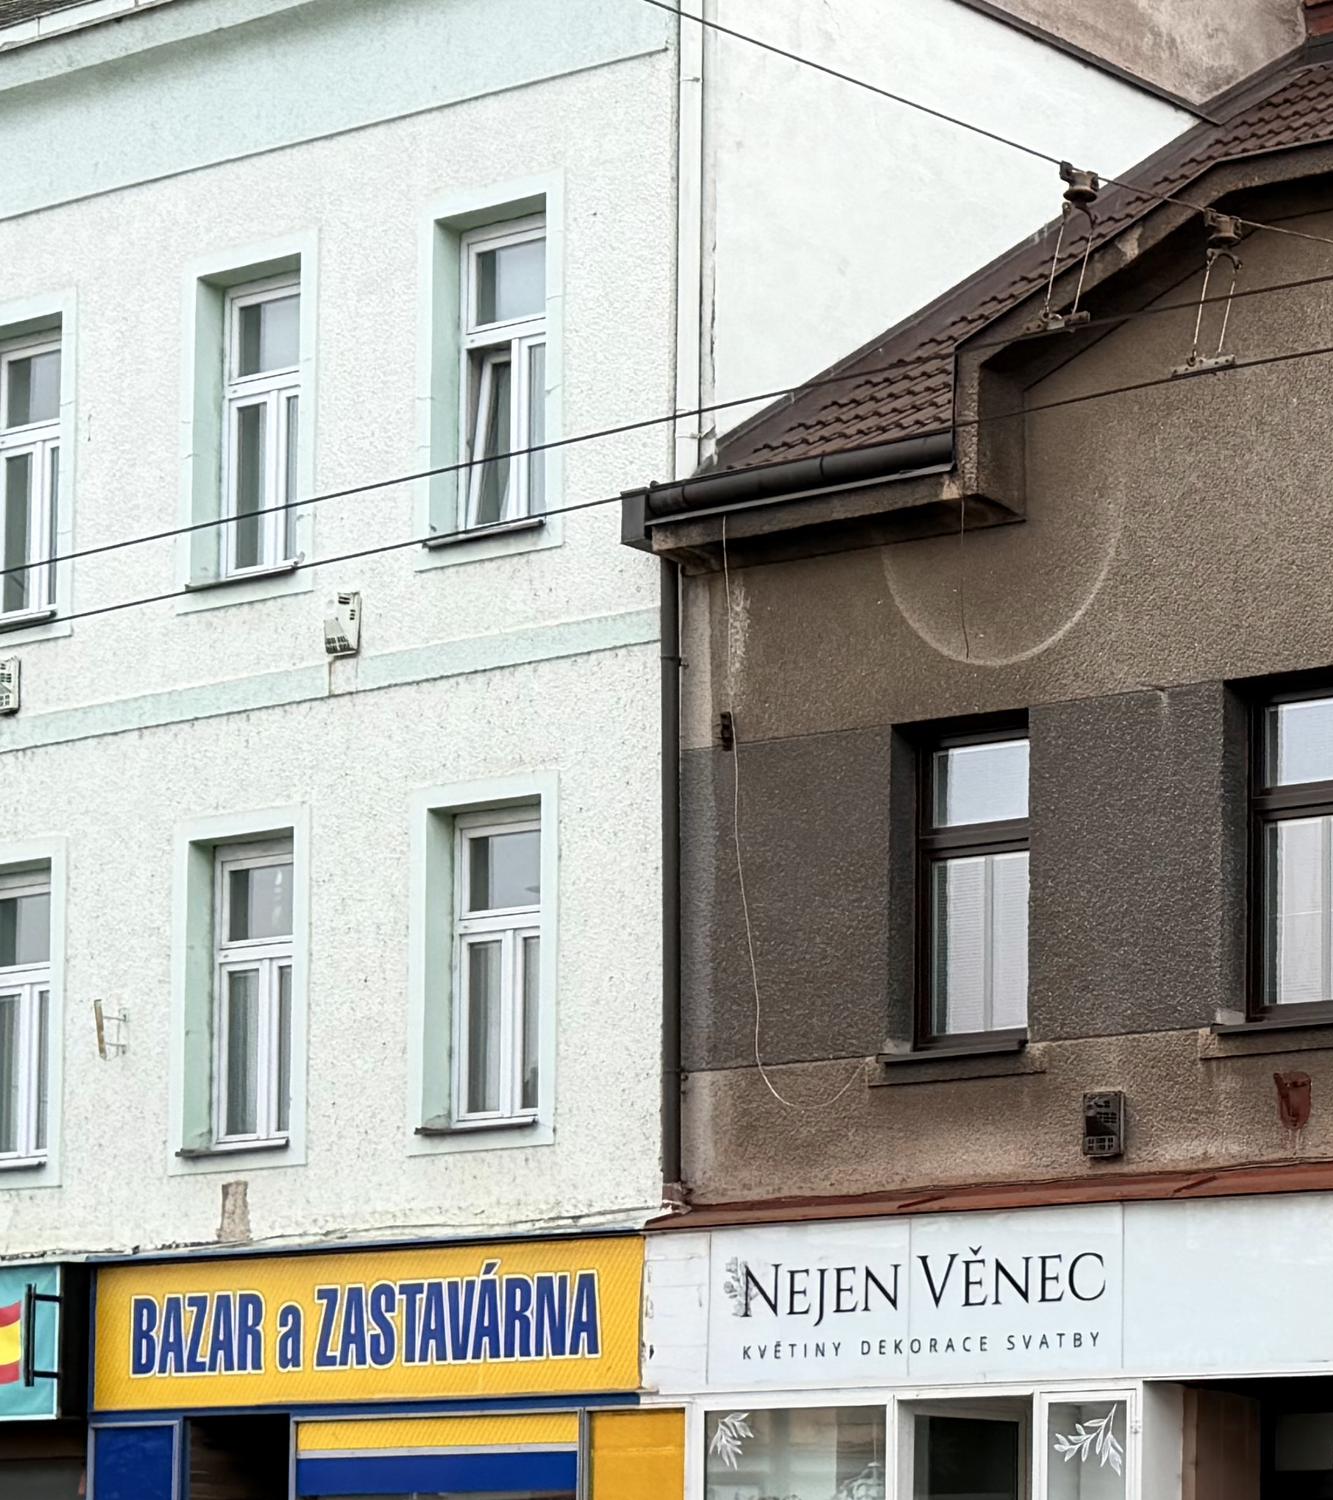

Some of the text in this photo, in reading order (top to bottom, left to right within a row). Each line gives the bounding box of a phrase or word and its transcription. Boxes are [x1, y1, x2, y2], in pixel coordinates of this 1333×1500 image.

[131, 1260, 602, 1377] BAZAR a ZASTAVÁRNA
[742, 1331, 1101, 1361] KVĚTINY DEKORACE SVATBY
